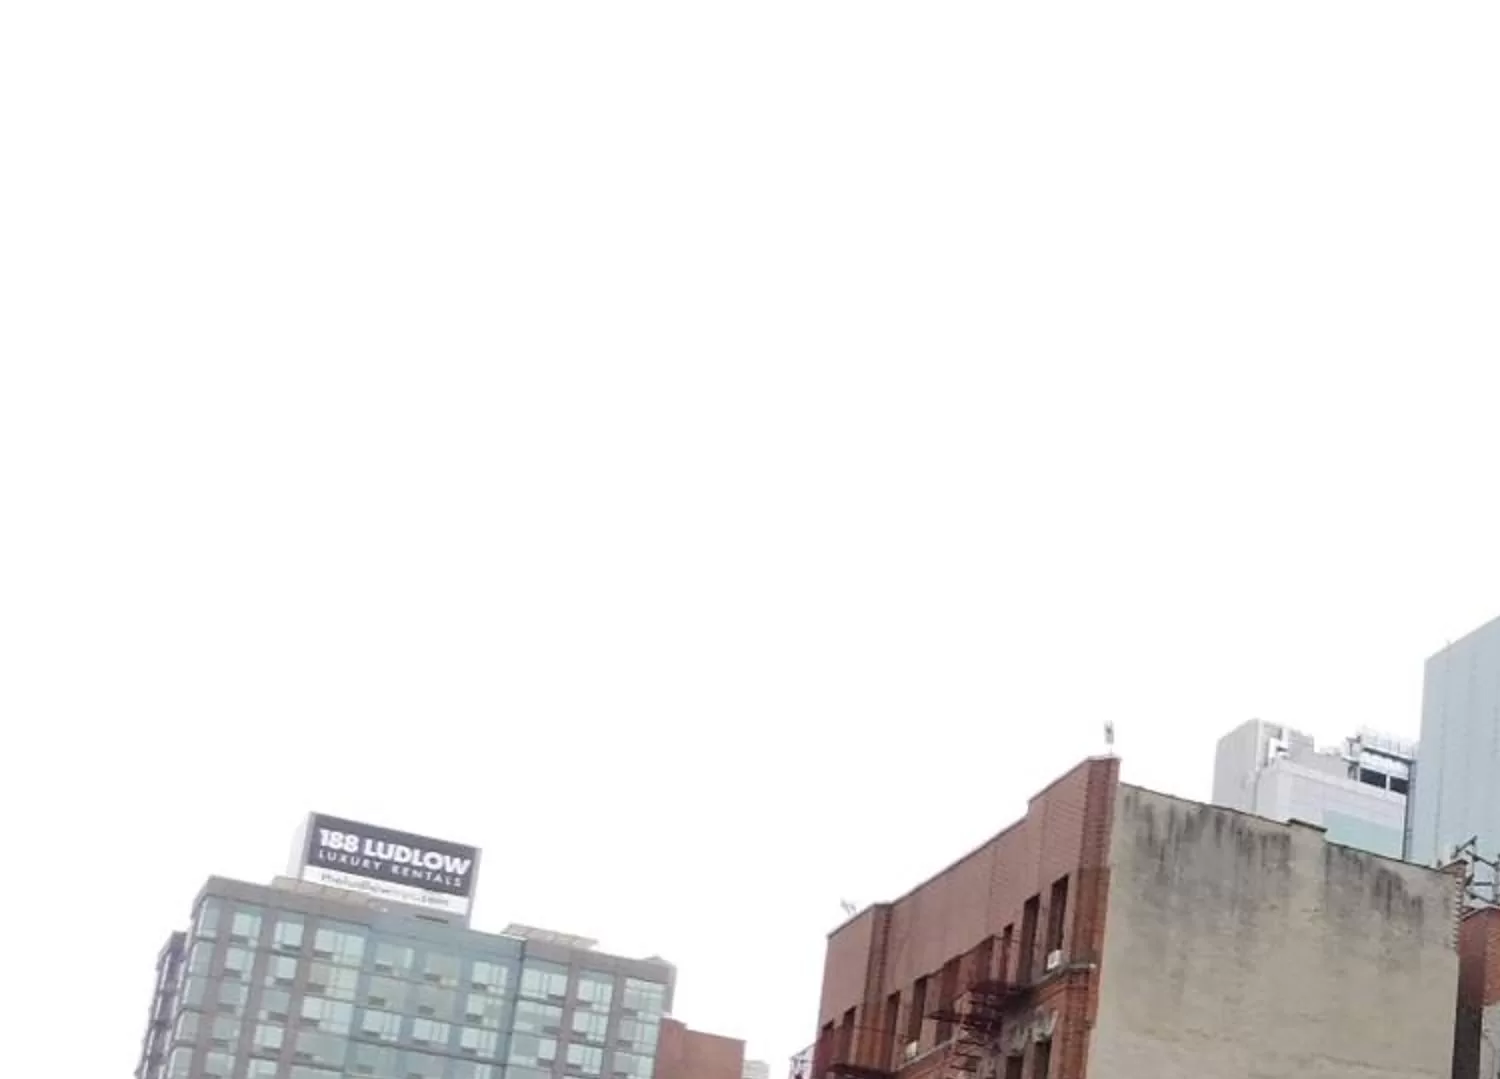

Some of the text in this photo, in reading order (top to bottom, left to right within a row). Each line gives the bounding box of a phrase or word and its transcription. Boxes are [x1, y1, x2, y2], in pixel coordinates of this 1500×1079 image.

[318, 850, 462, 887] LUXURY RENTALS
[319, 828, 472, 875] 188 LUDLOW
